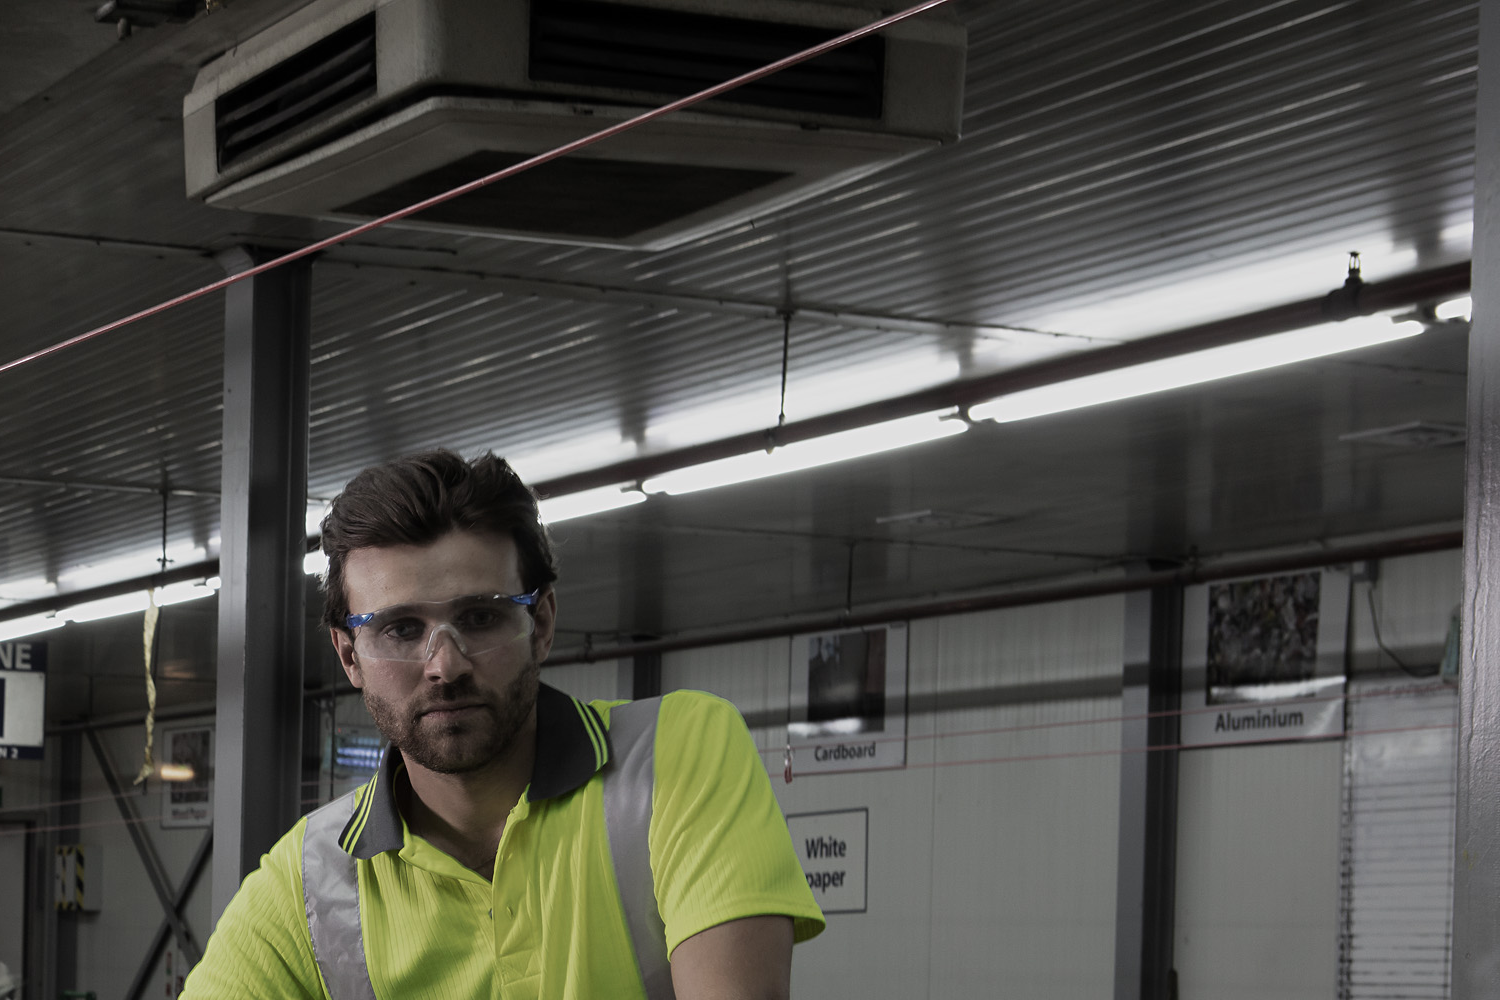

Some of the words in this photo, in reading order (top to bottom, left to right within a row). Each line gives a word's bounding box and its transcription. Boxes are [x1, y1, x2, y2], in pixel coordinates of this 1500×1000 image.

[1215, 708, 1304, 732] Aluminium
[11, 747, 19, 759] 2
[814, 741, 876, 762] Cardboard
[805, 836, 847, 858] White
[806, 871, 846, 893] paper
